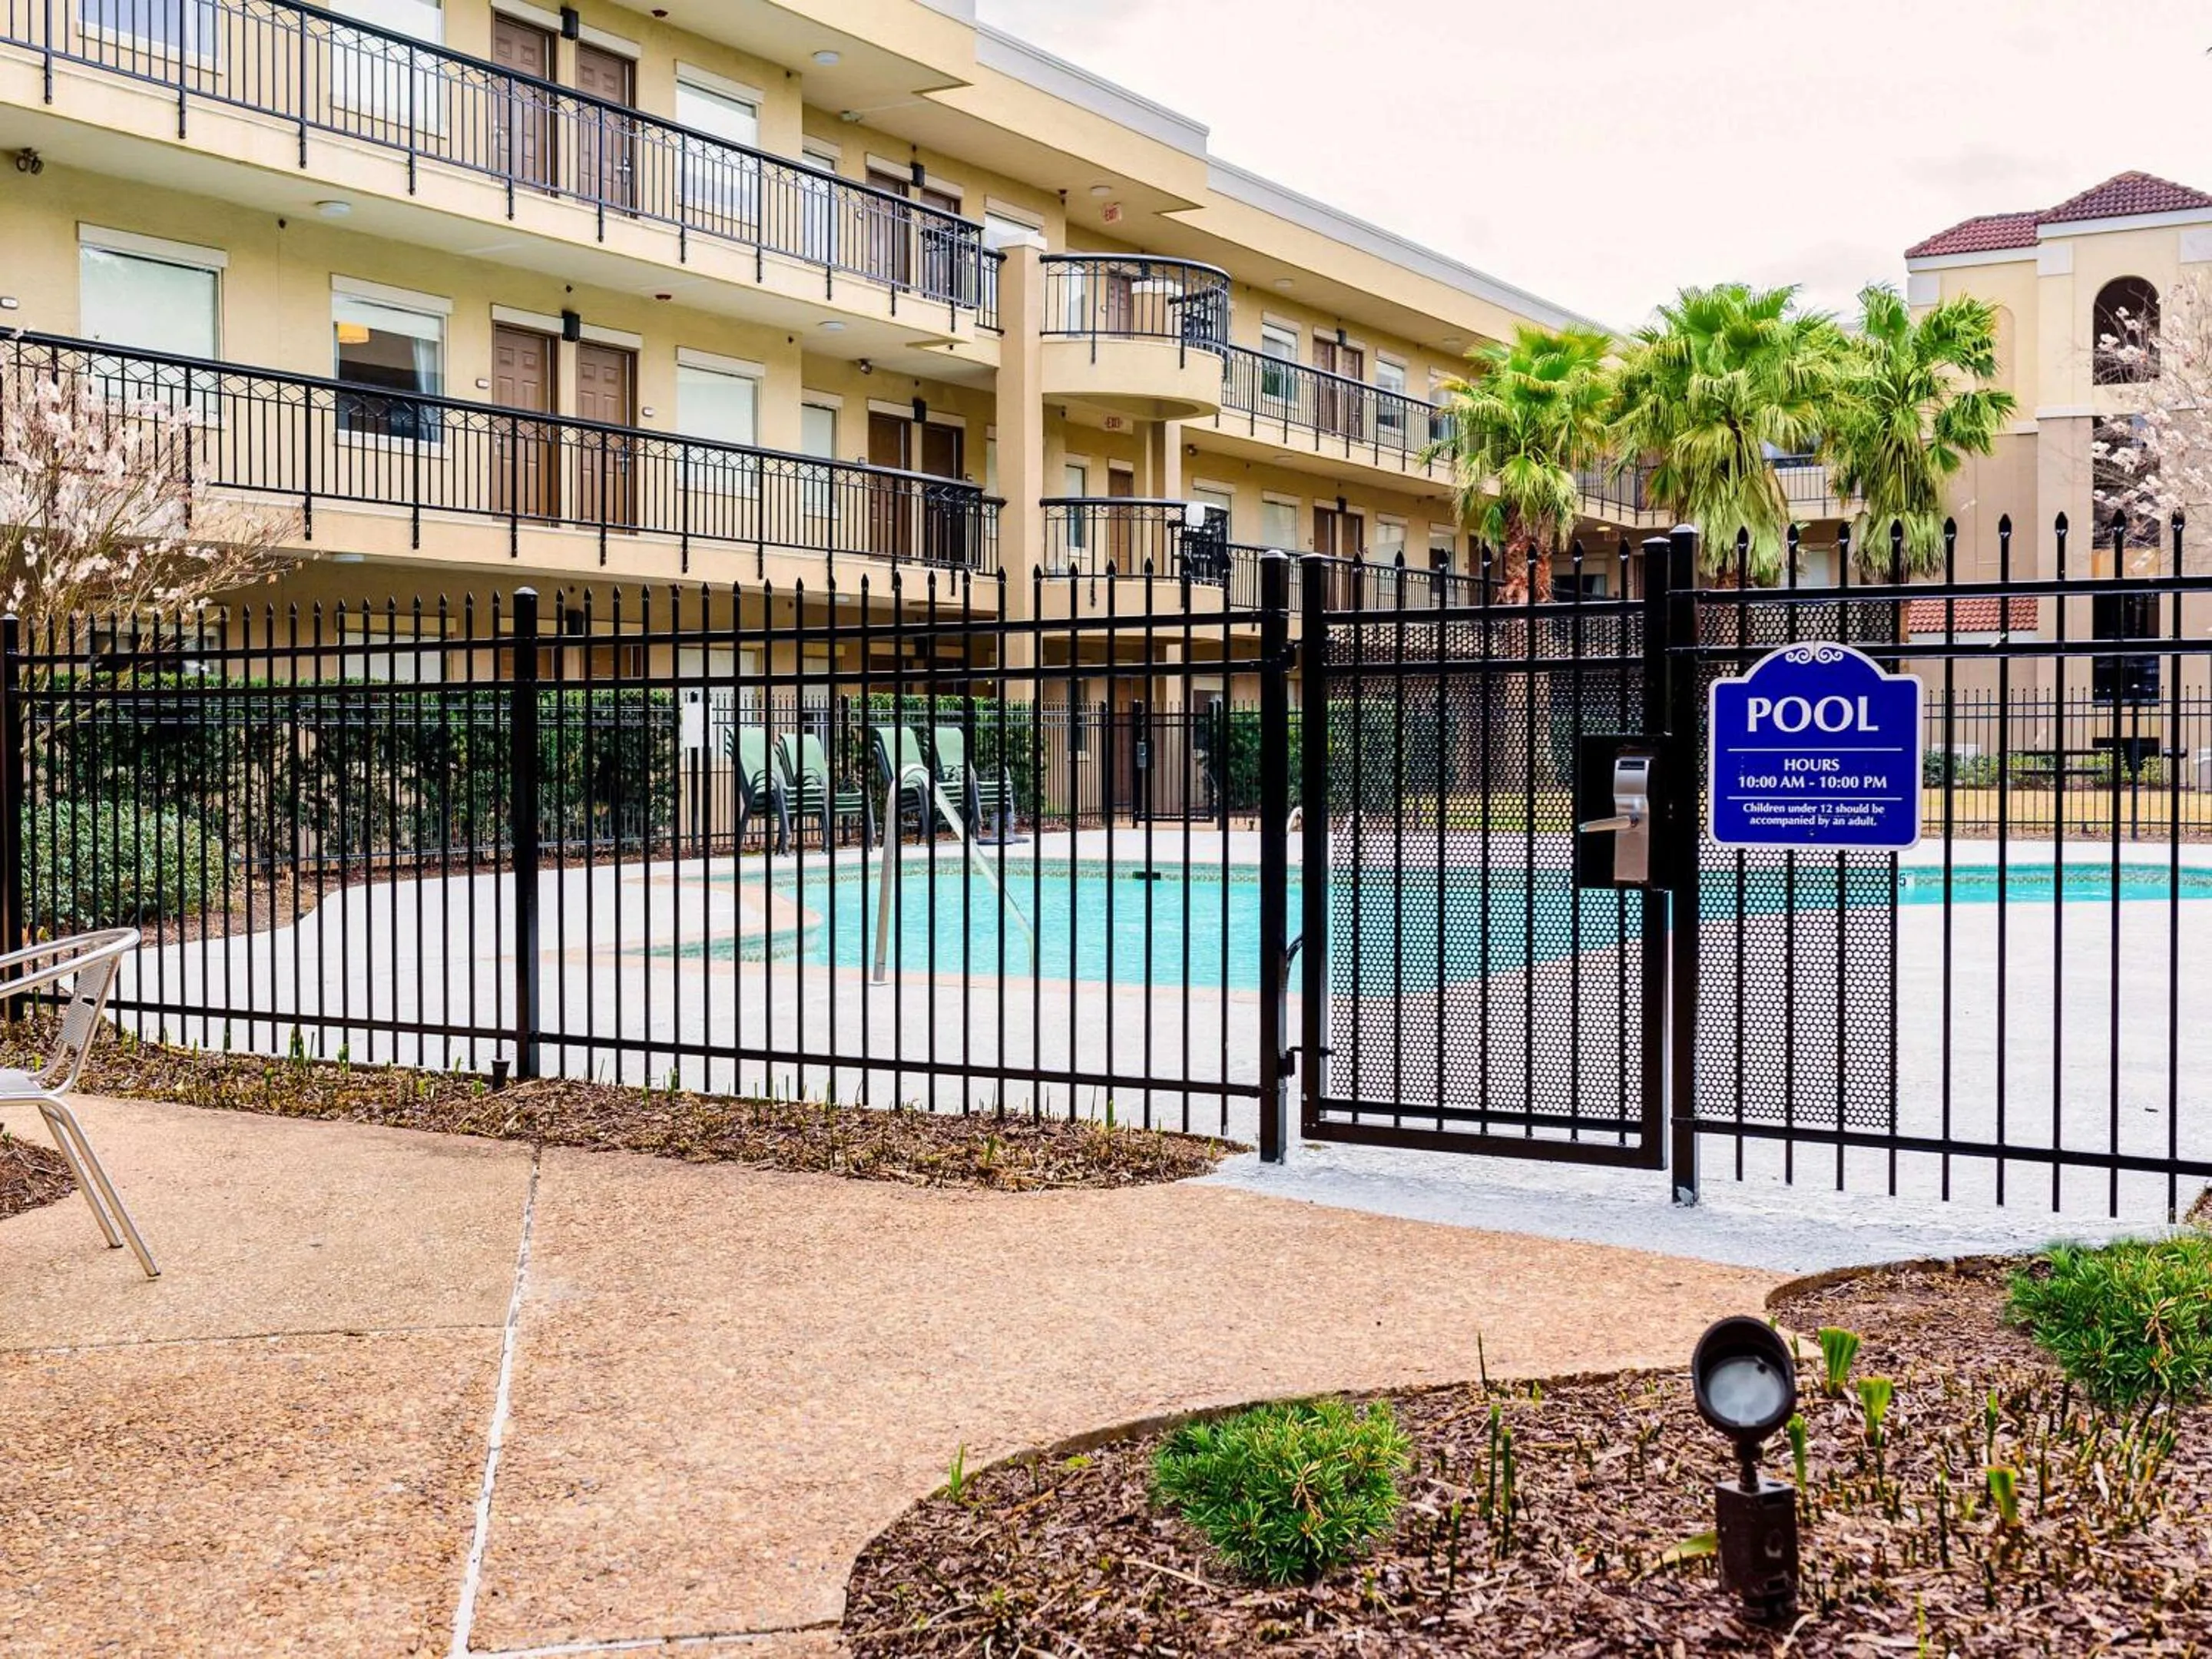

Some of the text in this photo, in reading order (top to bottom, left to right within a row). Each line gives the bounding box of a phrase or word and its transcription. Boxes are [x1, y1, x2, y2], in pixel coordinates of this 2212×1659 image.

[1747, 695, 1879, 733] POOL
[1783, 758, 1840, 772] HOURS
[1738, 775, 1777, 788] 10:00
[1780, 775, 1805, 788] AM
[1820, 776, 1859, 789] 10:00
[1863, 776, 1887, 789] PM
[1742, 803, 1885, 814] Children under 12 should be
[1749, 815, 1877, 828] accompanied by an adult.
